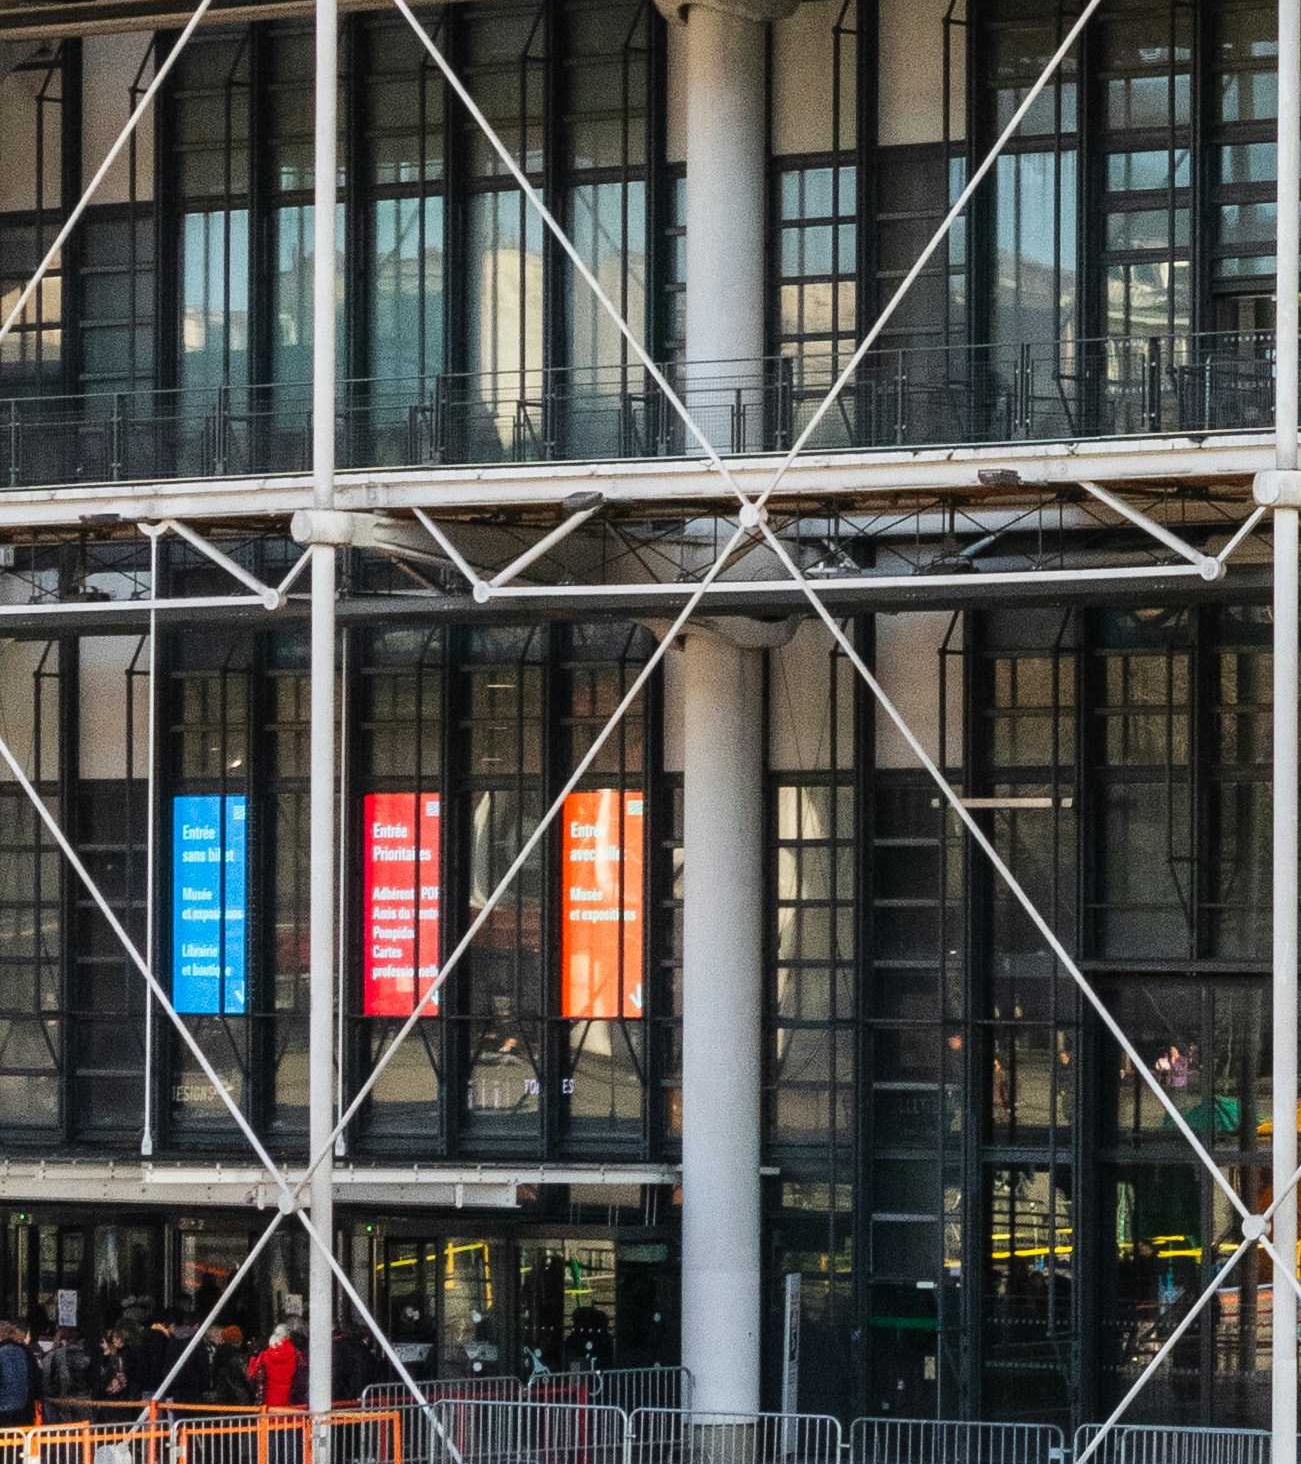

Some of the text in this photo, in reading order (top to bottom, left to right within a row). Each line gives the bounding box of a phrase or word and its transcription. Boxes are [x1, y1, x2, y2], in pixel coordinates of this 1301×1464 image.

[182, 824, 216, 840] Entrée
[373, 822, 408, 839] Entrée
[182, 846, 235, 862] sans bilet
[373, 845, 432, 861] Prioritaies
[182, 887, 212, 900] Musée
[570, 887, 603, 901] Musée
[182, 908, 191, 920] et
[372, 906, 396, 920] Amis
[398, 906, 410, 920] du
[570, 909, 580, 921] et
[182, 944, 218, 958] Librairie
[372, 945, 403, 958] Cartes
[182, 962, 232, 978] et boutiqe
